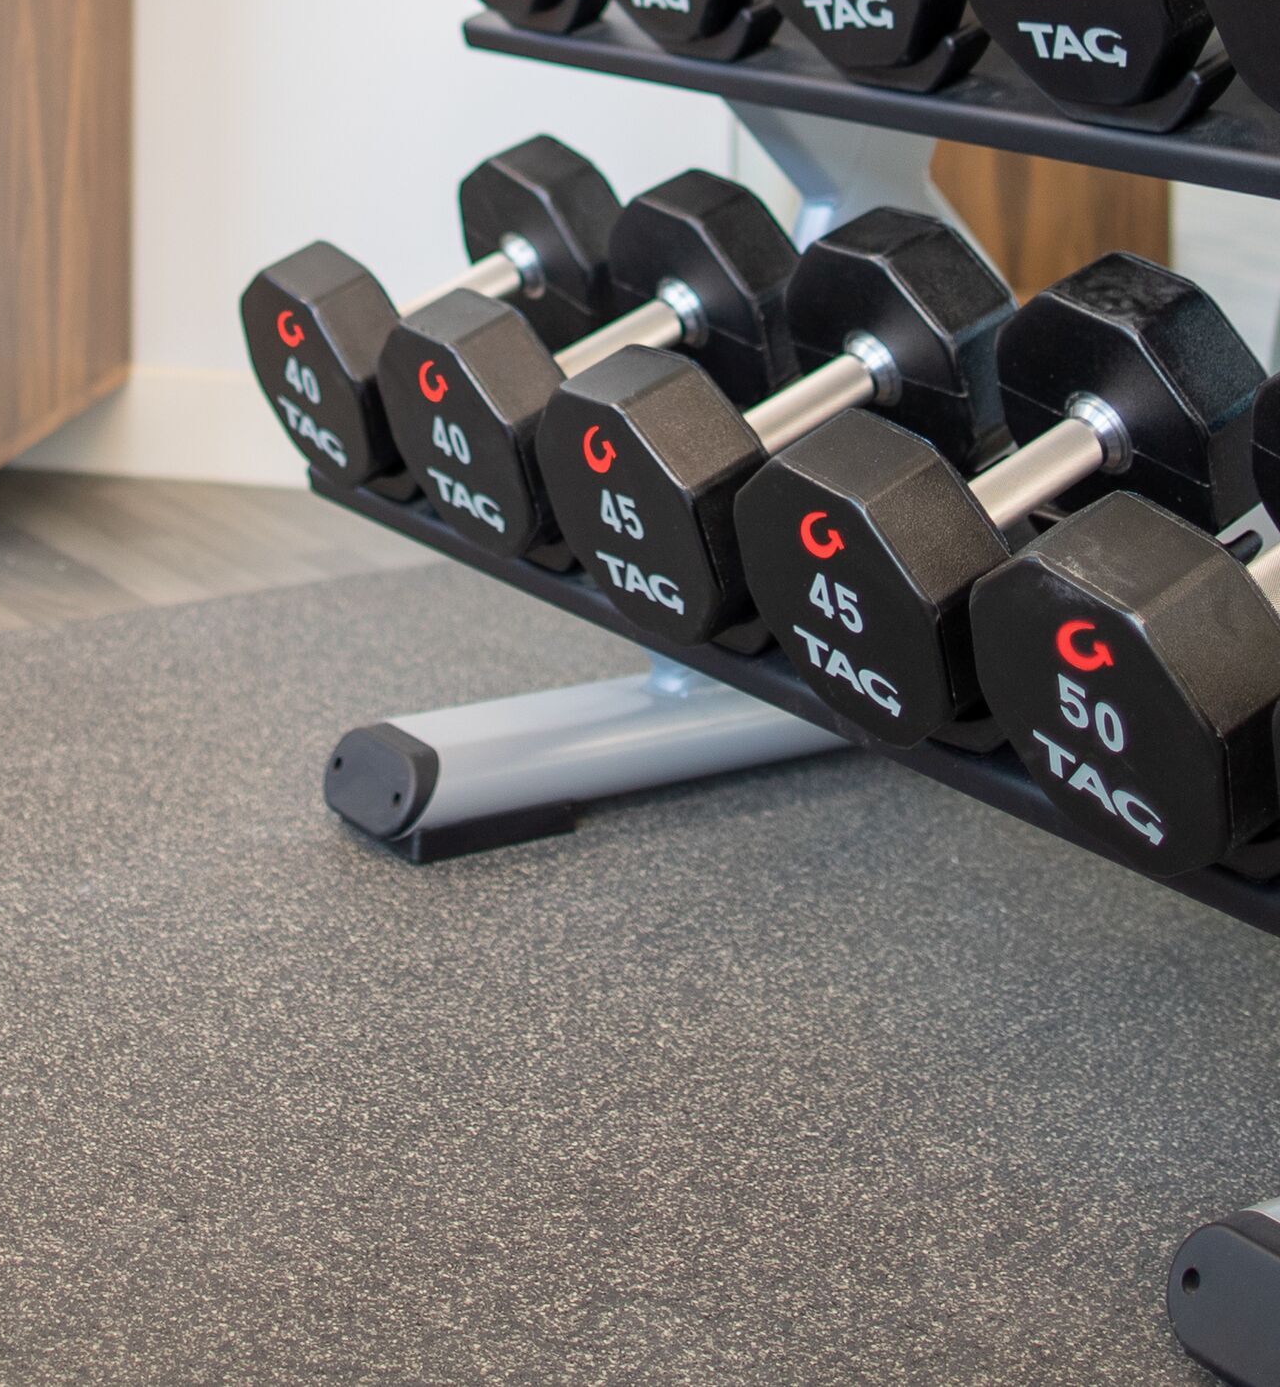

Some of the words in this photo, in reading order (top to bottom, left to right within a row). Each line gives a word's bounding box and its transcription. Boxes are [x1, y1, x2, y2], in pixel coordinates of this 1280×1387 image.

[1018, 22, 1127, 67] TAG
[284, 358, 320, 406] 40
[278, 395, 346, 468] TAG
[433, 417, 470, 464] 40
[428, 468, 504, 532] TAG
[601, 490, 643, 539] 45
[596, 551, 684, 614] TAG
[809, 573, 863, 633] 45
[793, 625, 901, 717] TAG
[1056, 674, 1124, 754] 50
[1031, 728, 1163, 846] TAG
